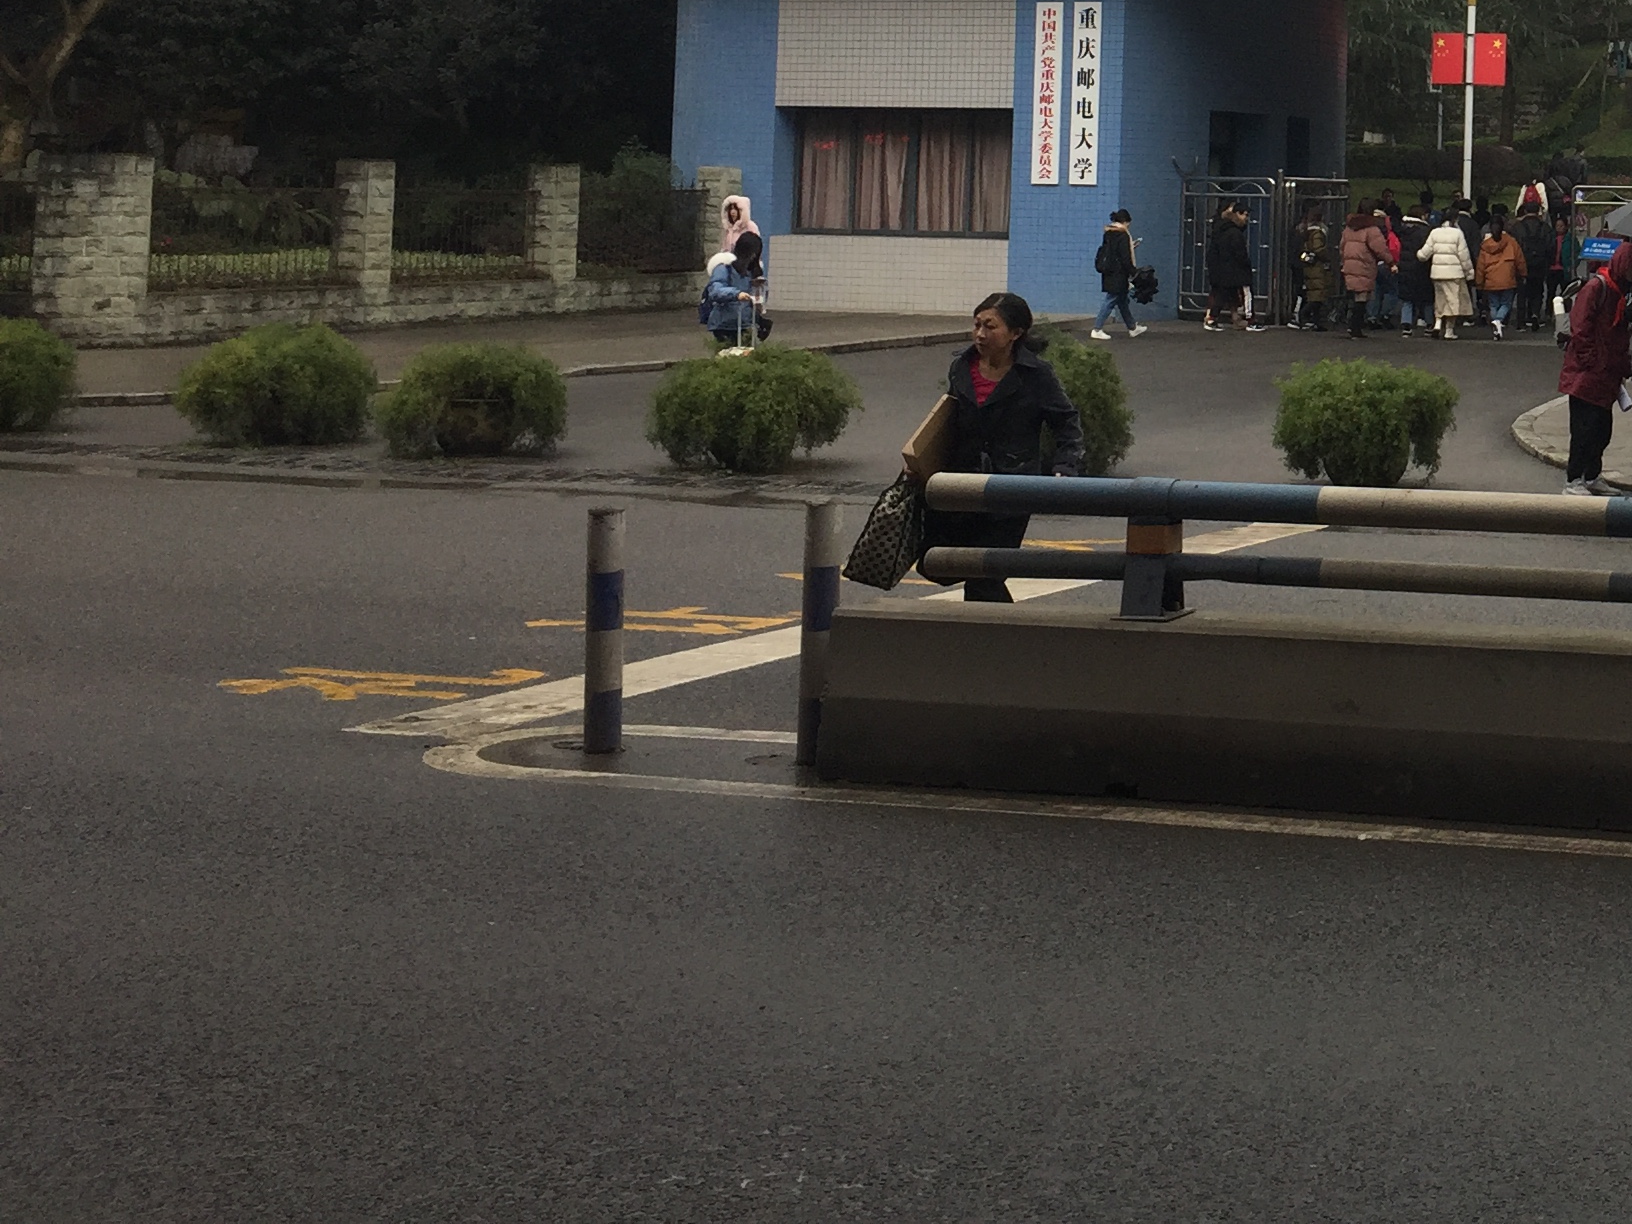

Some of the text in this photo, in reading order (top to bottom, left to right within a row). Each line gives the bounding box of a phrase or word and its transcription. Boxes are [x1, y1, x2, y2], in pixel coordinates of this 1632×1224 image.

[1038, 8, 1056, 180] 中国共产党重庆邮电大学委员会
[1074, 7, 1097, 180] 重庆邮电大学
